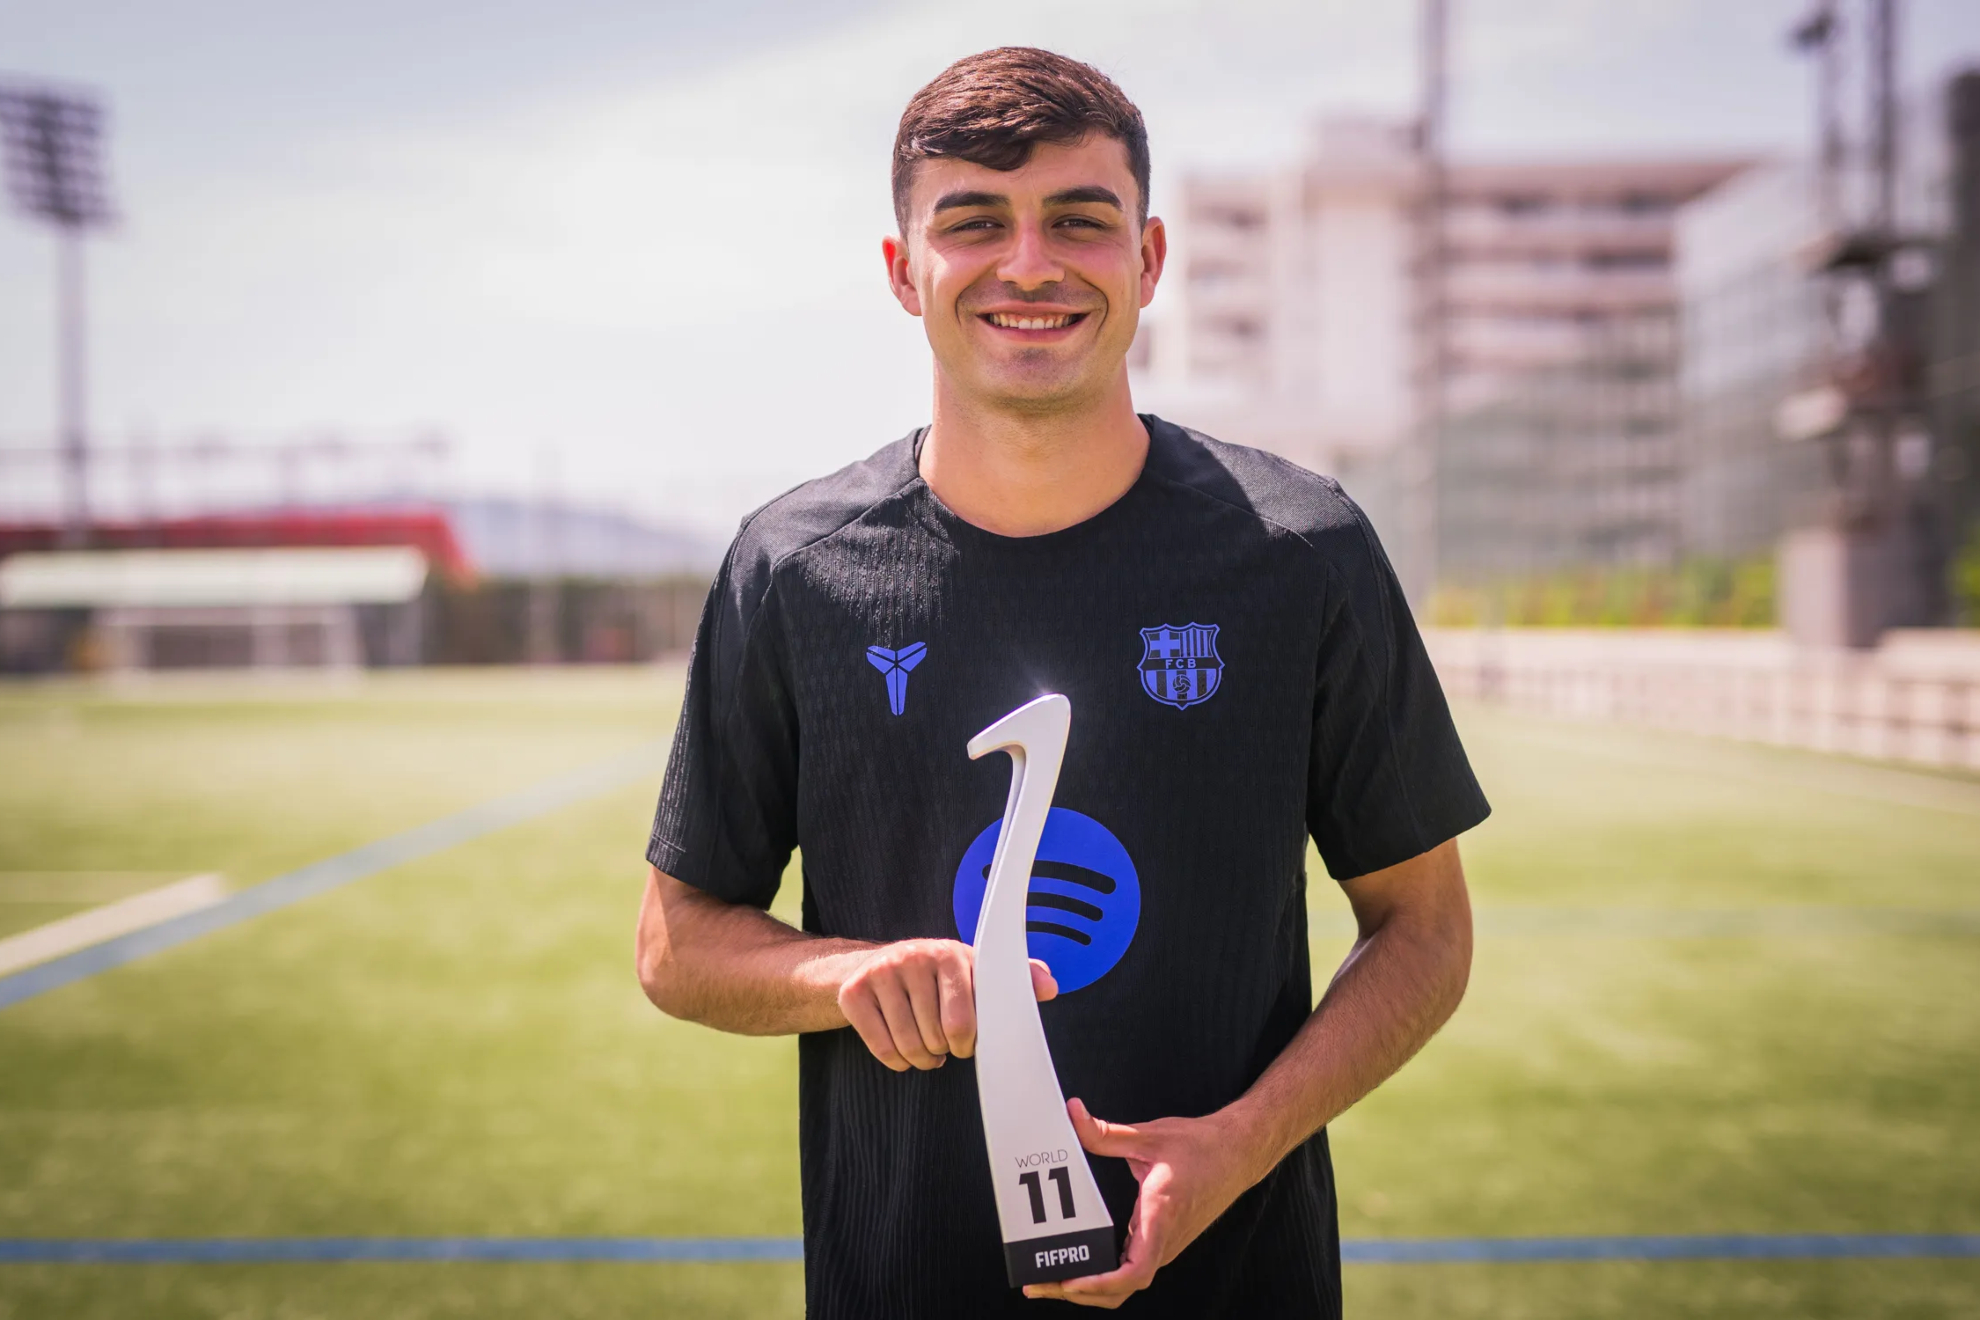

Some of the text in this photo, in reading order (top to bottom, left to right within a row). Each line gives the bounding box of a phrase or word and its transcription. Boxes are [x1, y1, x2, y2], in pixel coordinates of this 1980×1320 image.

[1165, 658, 1196, 669] FCB
[1015, 1149, 1068, 1168] WORLD
[1019, 1166, 1076, 1224] 11
[1035, 1245, 1090, 1268] FIFPRO
